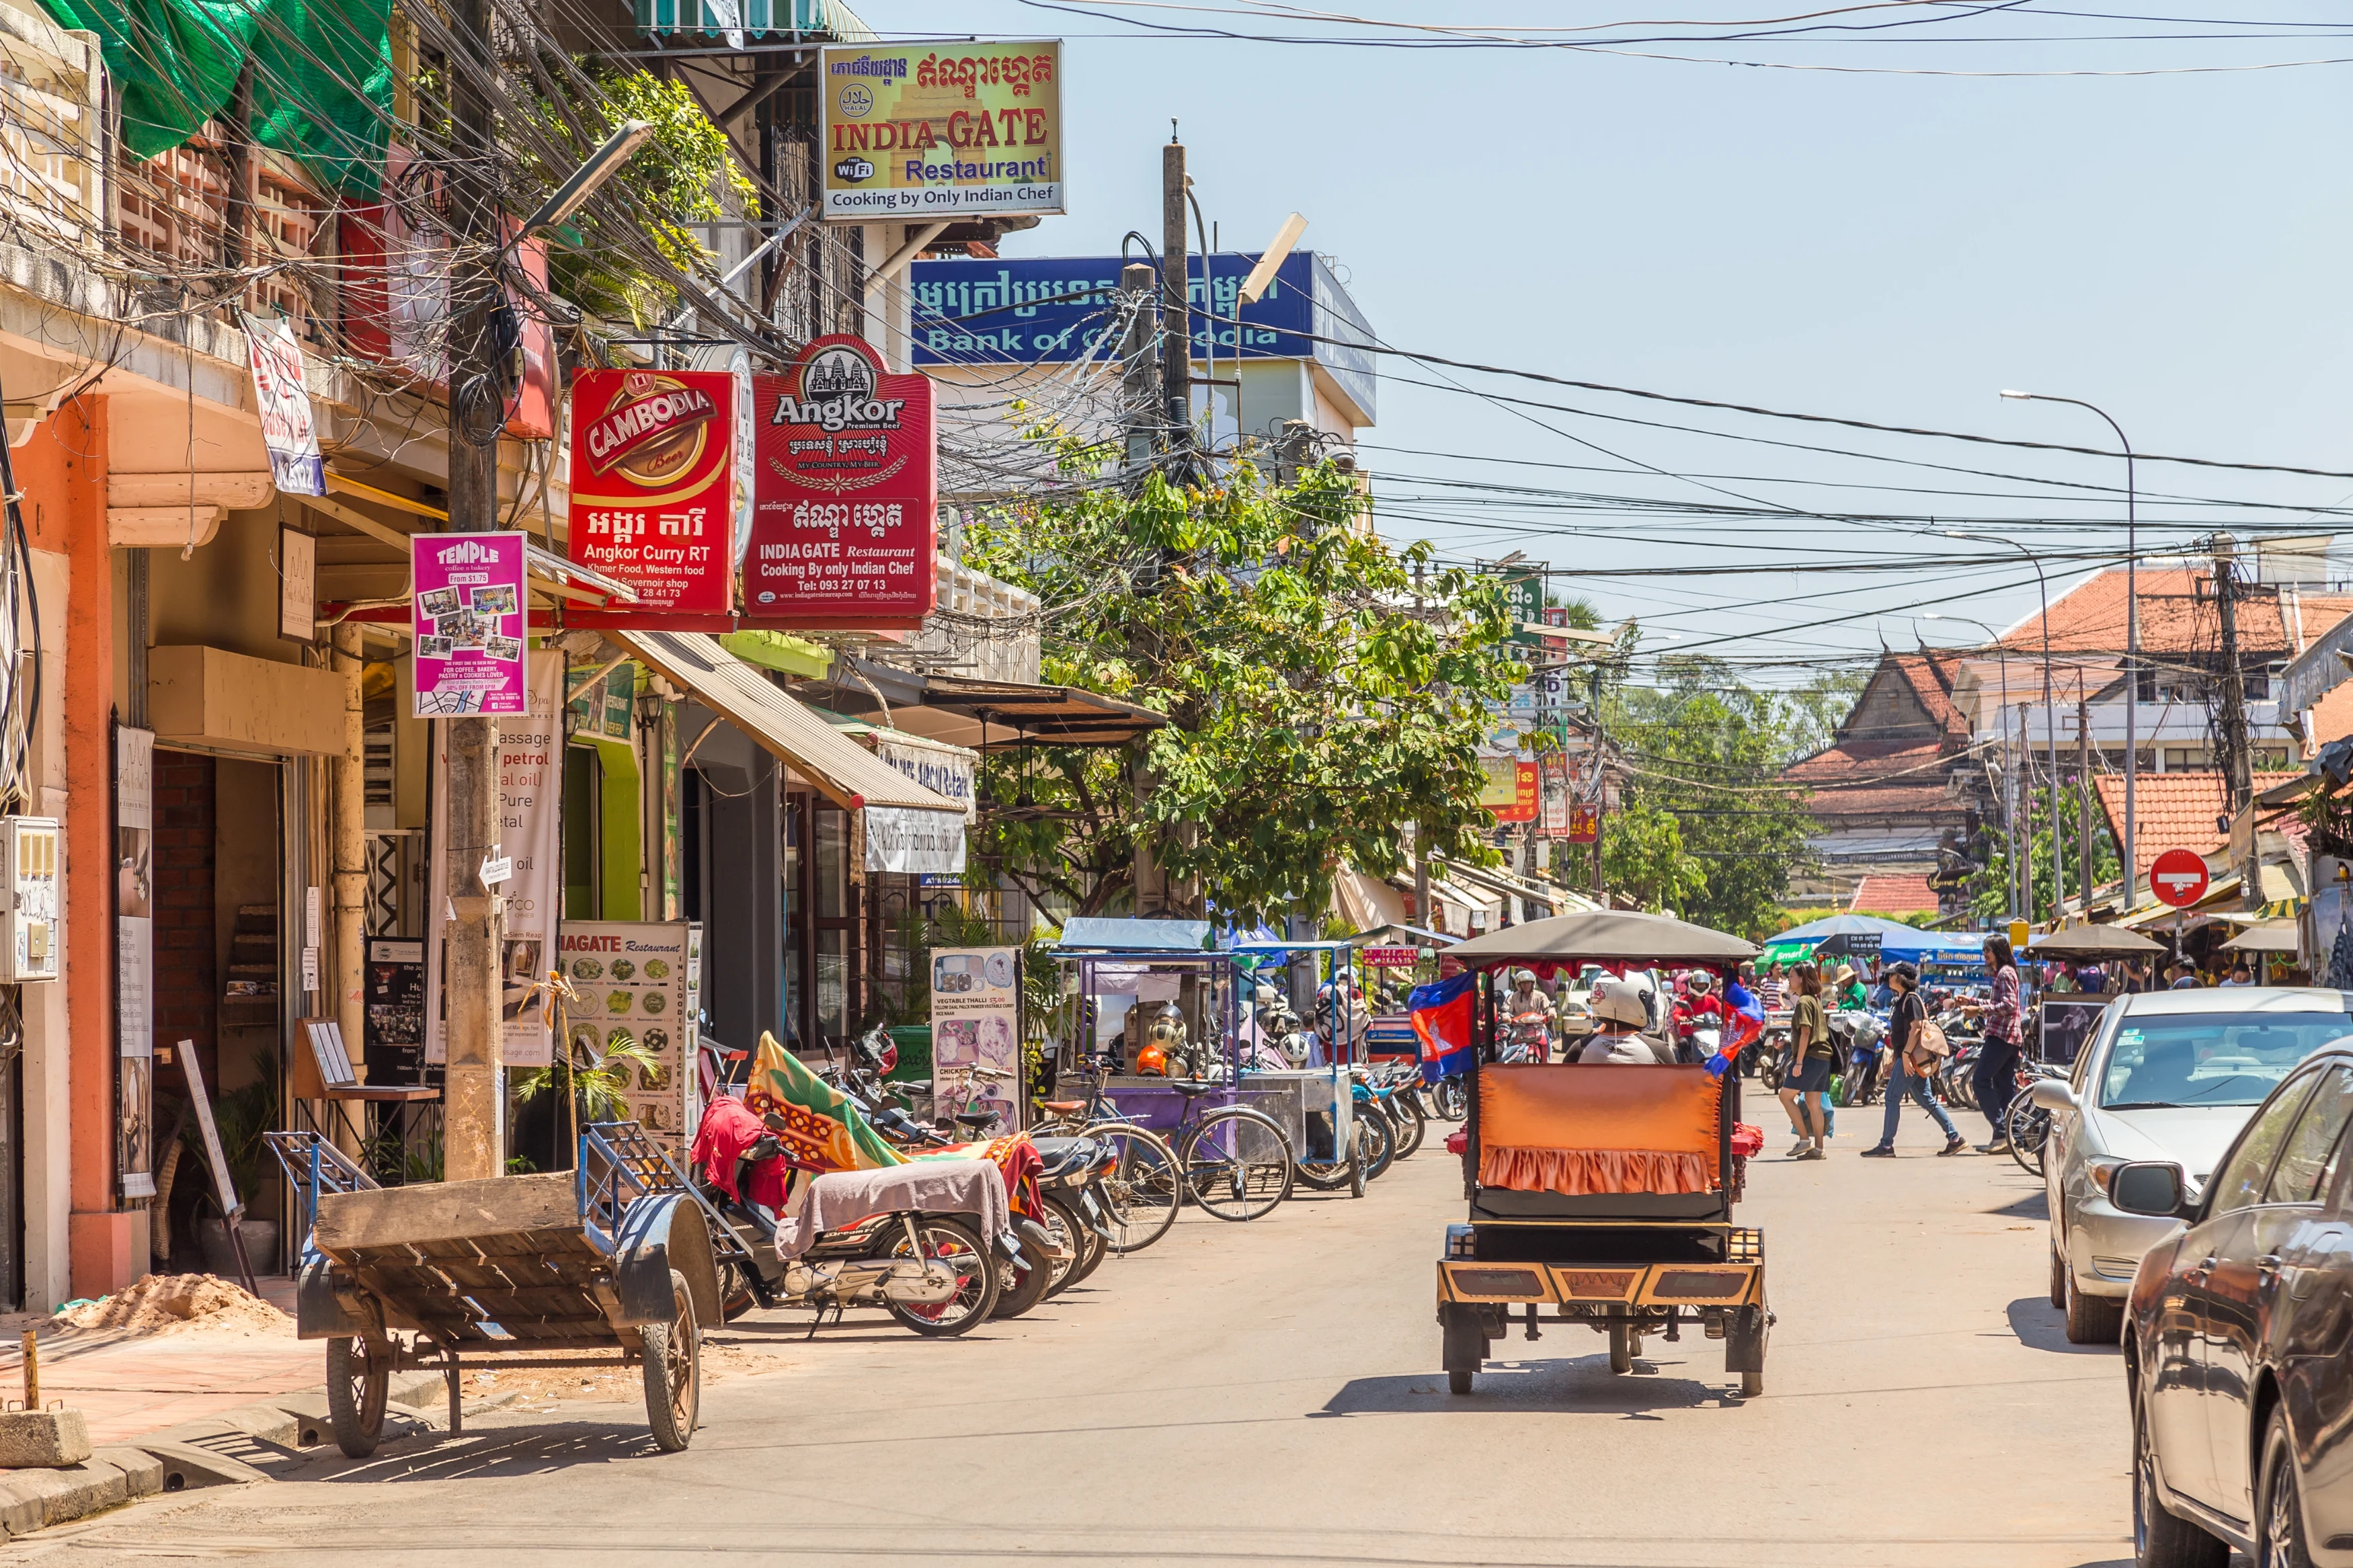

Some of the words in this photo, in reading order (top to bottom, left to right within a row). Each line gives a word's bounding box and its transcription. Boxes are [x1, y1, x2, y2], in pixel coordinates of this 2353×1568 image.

[842, 90, 871, 106] حلال
[832, 121, 938, 153] INDIA
[947, 108, 1049, 149] GATE
[905, 156, 1046, 181] Restaurant
[832, 192, 898, 208] Cooking
[901, 191, 920, 207] by
[924, 190, 961, 206] Only
[965, 188, 1013, 202] Indian
[1016, 185, 1053, 201] Chef
[928, 329, 1025, 352] Bank
[1033, 327, 1072, 351] of
[773, 393, 904, 431] Angkor
[588, 390, 711, 458] CAMBODIA
[647, 450, 684, 473] Beer
[436, 540, 500, 565] TEMPLE
[584, 543, 640, 563] Angkor
[643, 545, 685, 564] Curry
[688, 546, 711, 561] RT
[760, 543, 801, 560] INDIA
[801, 542, 840, 559] GATE
[846, 545, 916, 558] Restaurant
[471, 564, 491, 572] bakery
[587, 563, 616, 574] Khmer
[618, 563, 644, 575] Food,
[645, 565, 682, 575] Western
[684, 565, 705, 576] food
[760, 563, 805, 579] Cooking
[808, 562, 823, 579] By
[825, 561, 848, 578] only
[851, 561, 886, 575] Indian
[888, 561, 914, 575] Chef
[468, 575, 487, 583] $1.75
[666, 579, 689, 590] shop
[797, 580, 817, 591] Tel:
[819, 580, 839, 591] 093
[841, 579, 854, 590] 27
[856, 579, 871, 590] 07
[873, 579, 886, 590] 13
[643, 588, 654, 597] 28
[655, 589, 667, 597] 41
[669, 589, 681, 597] 73
[795, 591, 853, 600] indiagatesiemreap.com
[499, 733, 551, 748] assage
[503, 751, 549, 768] petrol
[519, 770, 542, 787] oil)
[516, 856, 534, 870] oil
[526, 932, 543, 940] Reap
[559, 935, 622, 952] IAGATE
[625, 940, 681, 953] Restaurant
[1776, 950, 1803, 960] Smart
[828, 1229, 864, 1237] Dream
